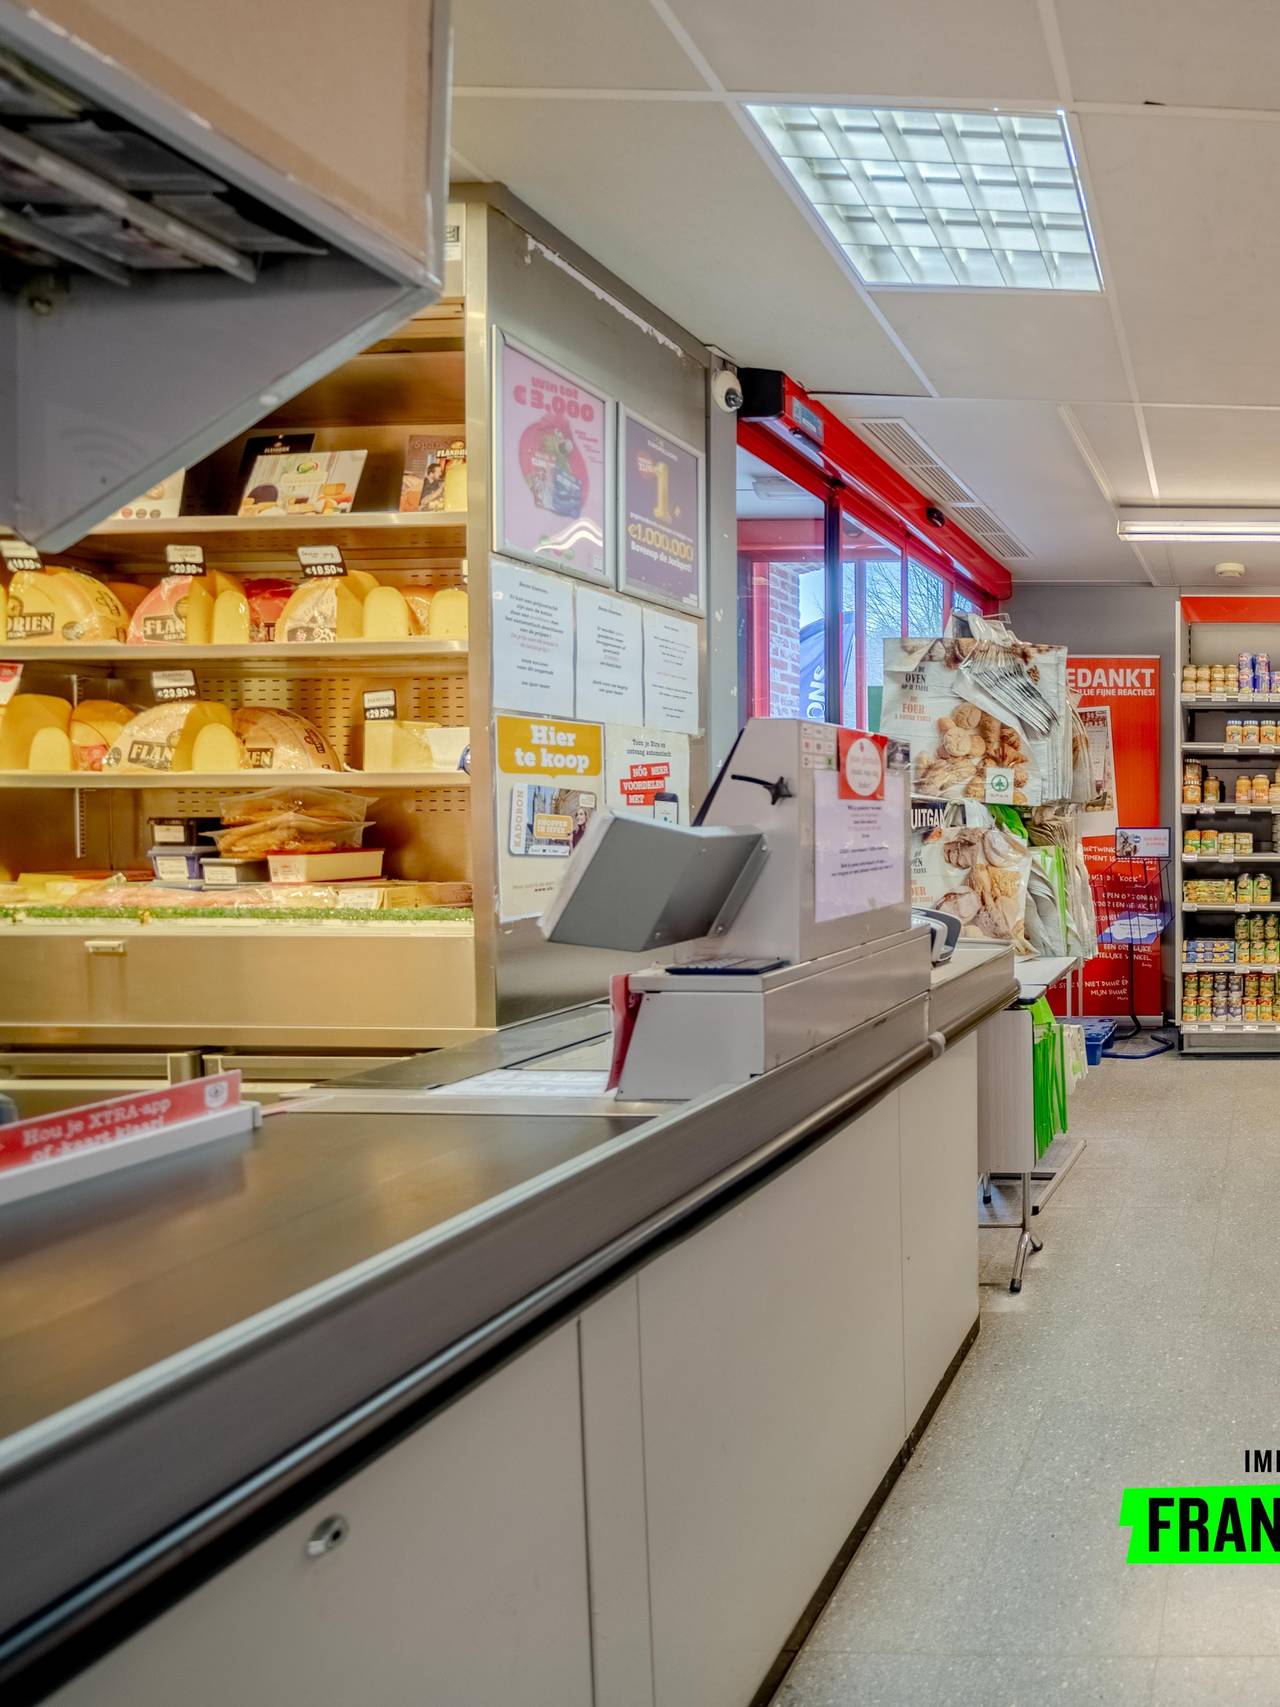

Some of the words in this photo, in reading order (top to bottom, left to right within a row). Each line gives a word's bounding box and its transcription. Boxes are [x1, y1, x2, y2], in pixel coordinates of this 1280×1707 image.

[905, 673, 927, 684] OVEN
[1066, 668, 1155, 687] EDANKT
[1096, 688, 1117, 696] FIJNE
[1117, 688, 1155, 696] REACTIES!
[902, 703, 925, 714] FOUR
[530, 724, 577, 748] Hier
[130, 744, 175, 761] FLAN
[515, 747, 536, 768] te
[541, 748, 590, 774] koop
[910, 808, 946, 830] UITGAN
[23, 1126, 63, 1147] Hou
[66, 1118, 84, 1138] je
[88, 1098, 172, 1129] XTRA-app
